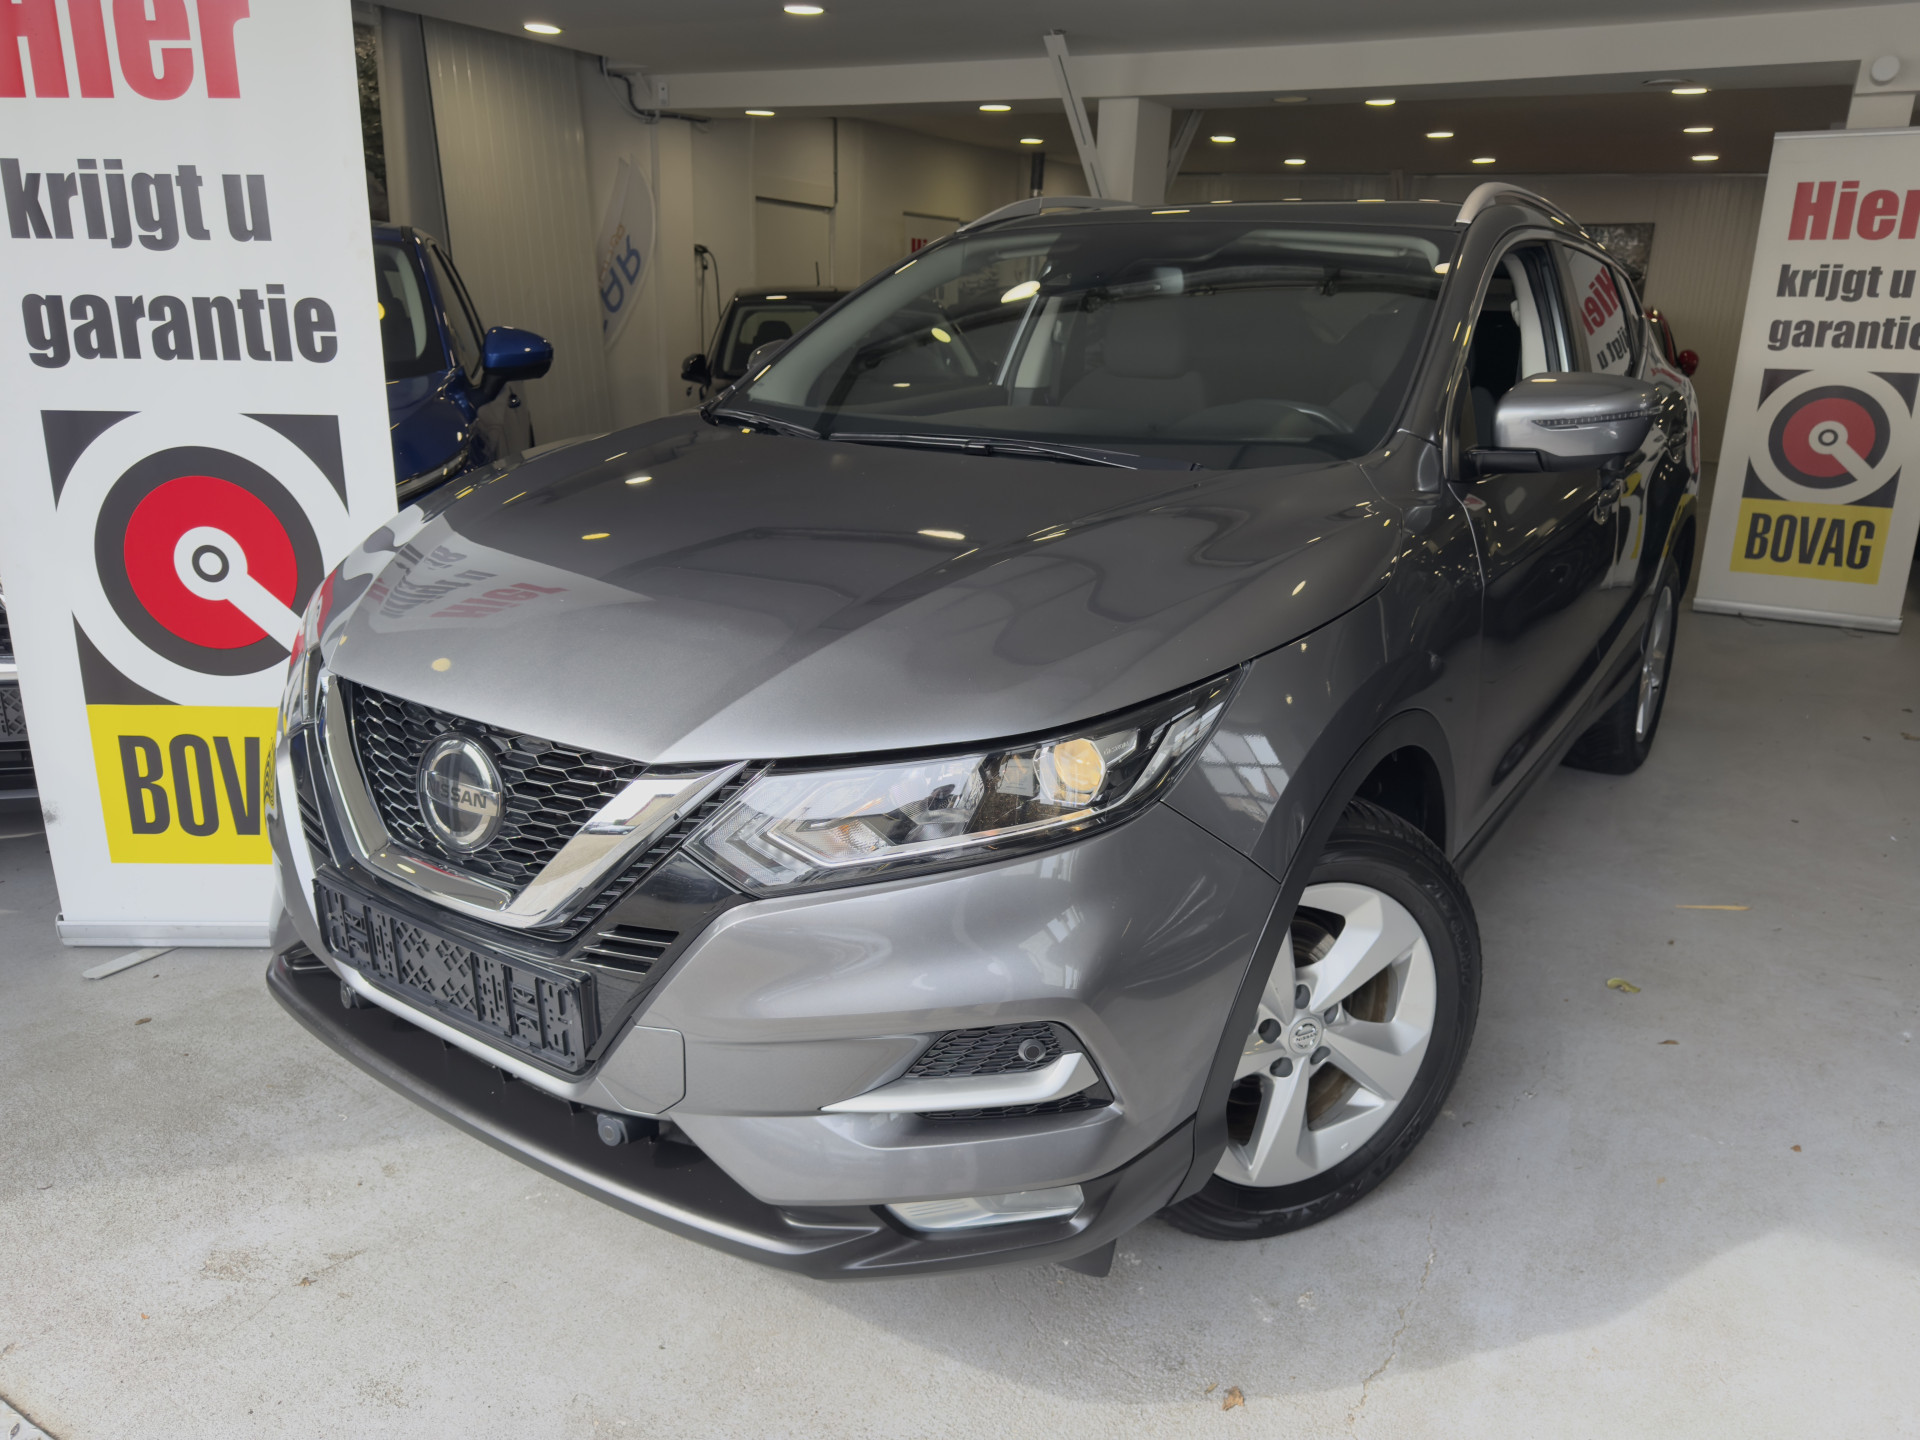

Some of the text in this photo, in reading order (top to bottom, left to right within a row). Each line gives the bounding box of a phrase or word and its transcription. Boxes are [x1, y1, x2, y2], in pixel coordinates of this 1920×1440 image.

[0, 158, 272, 251] krijgt u
[1788, 180, 1920, 241] Hier
[1776, 264, 1917, 302] krijgt u
[22, 284, 338, 369] garantie
[1744, 512, 1875, 570] BOVAG
[117, 733, 261, 837] BOV
[429, 781, 487, 809] NISSAN
